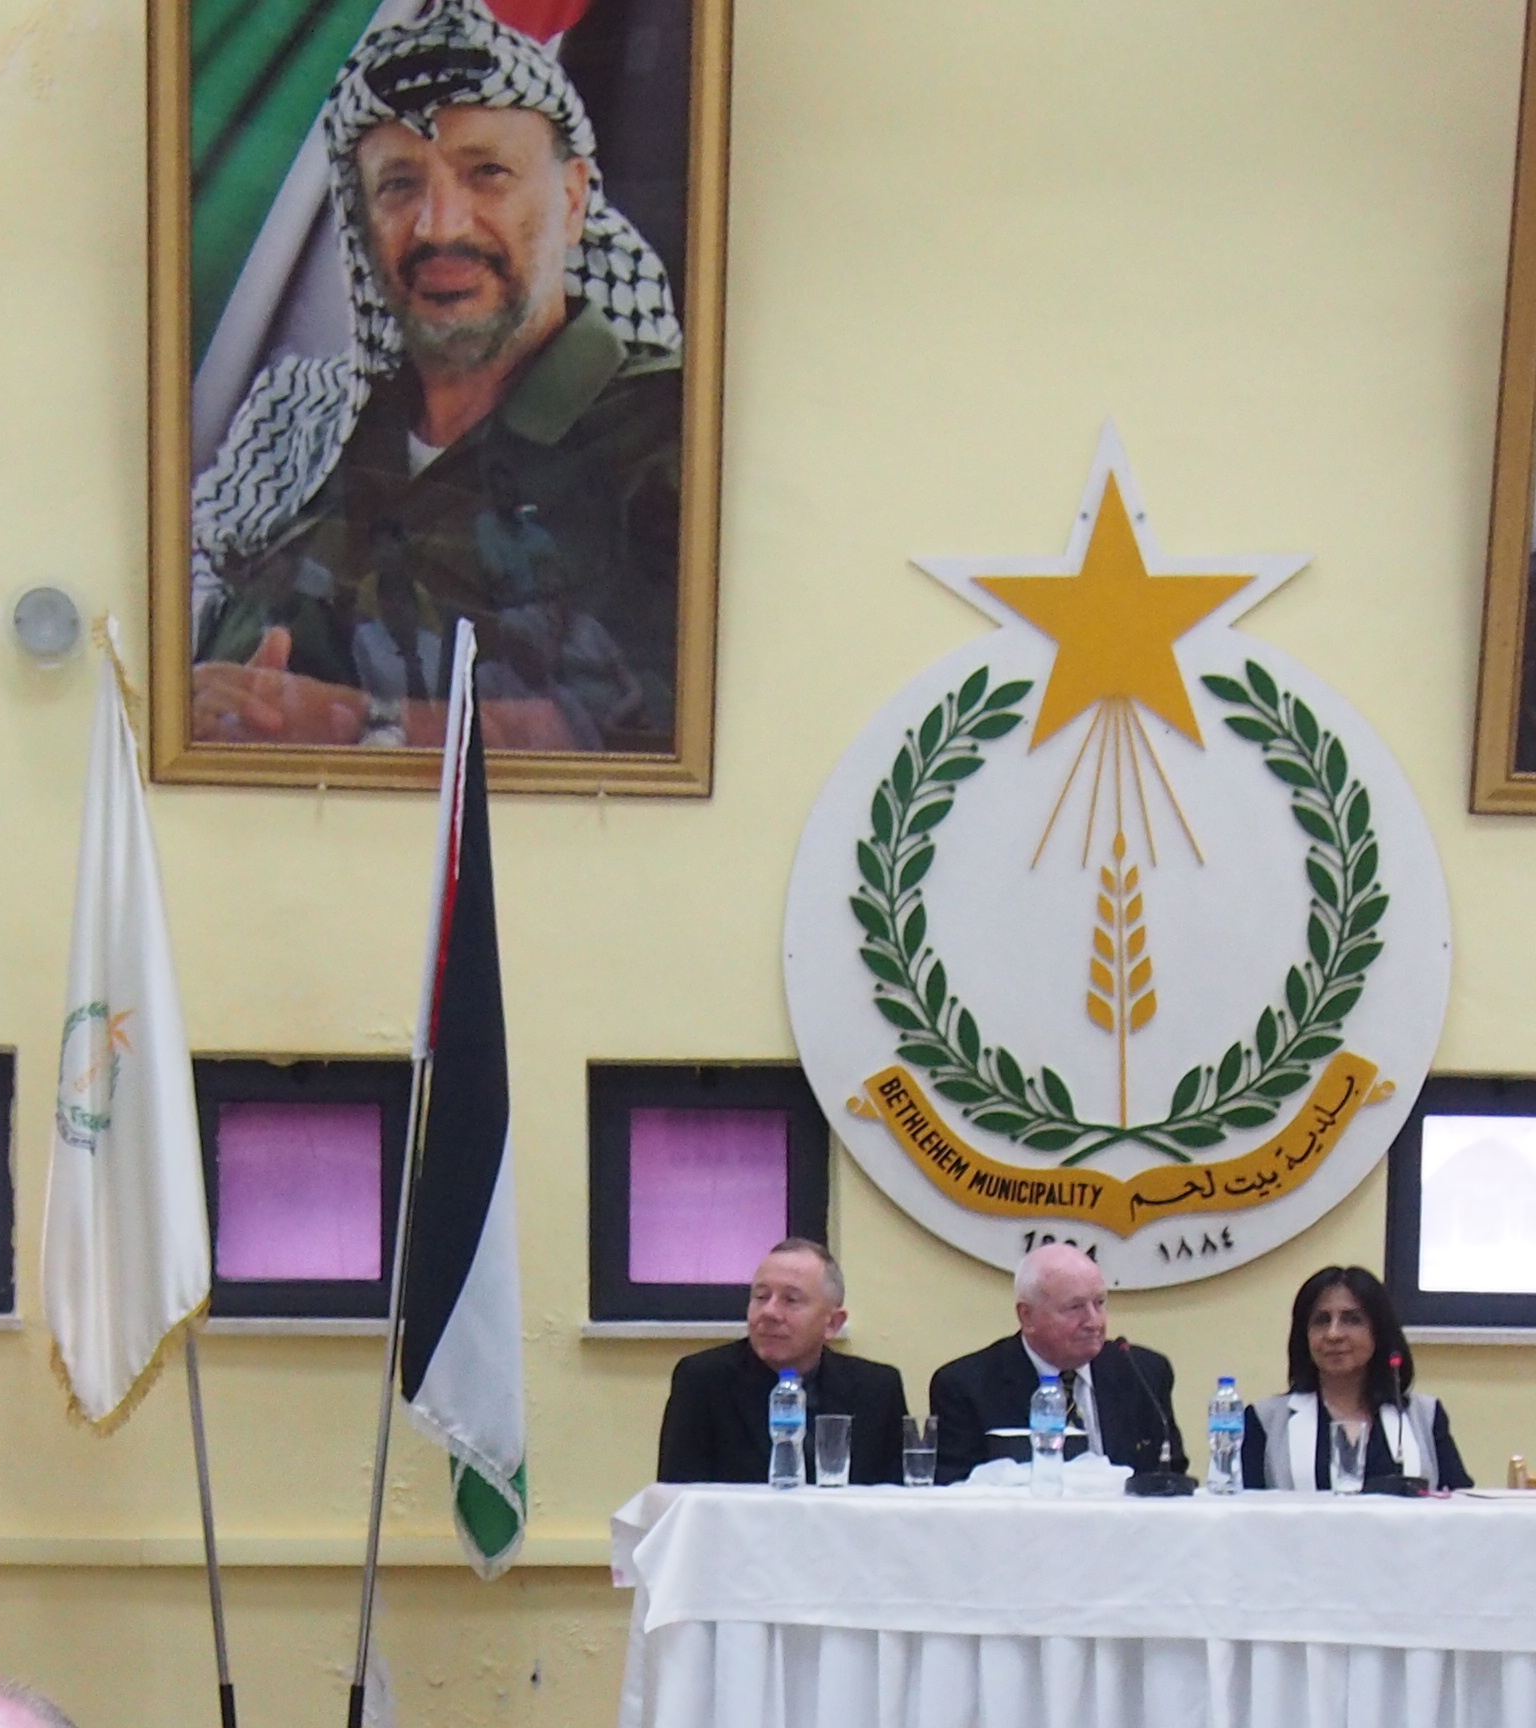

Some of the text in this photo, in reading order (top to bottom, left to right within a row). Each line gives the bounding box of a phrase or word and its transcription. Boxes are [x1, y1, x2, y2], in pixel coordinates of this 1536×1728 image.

[878, 1077, 1104, 1209] BETHLEHEM MUNICIPALITY
[1129, 1074, 1359, 1222] بلدية بيت لحم
